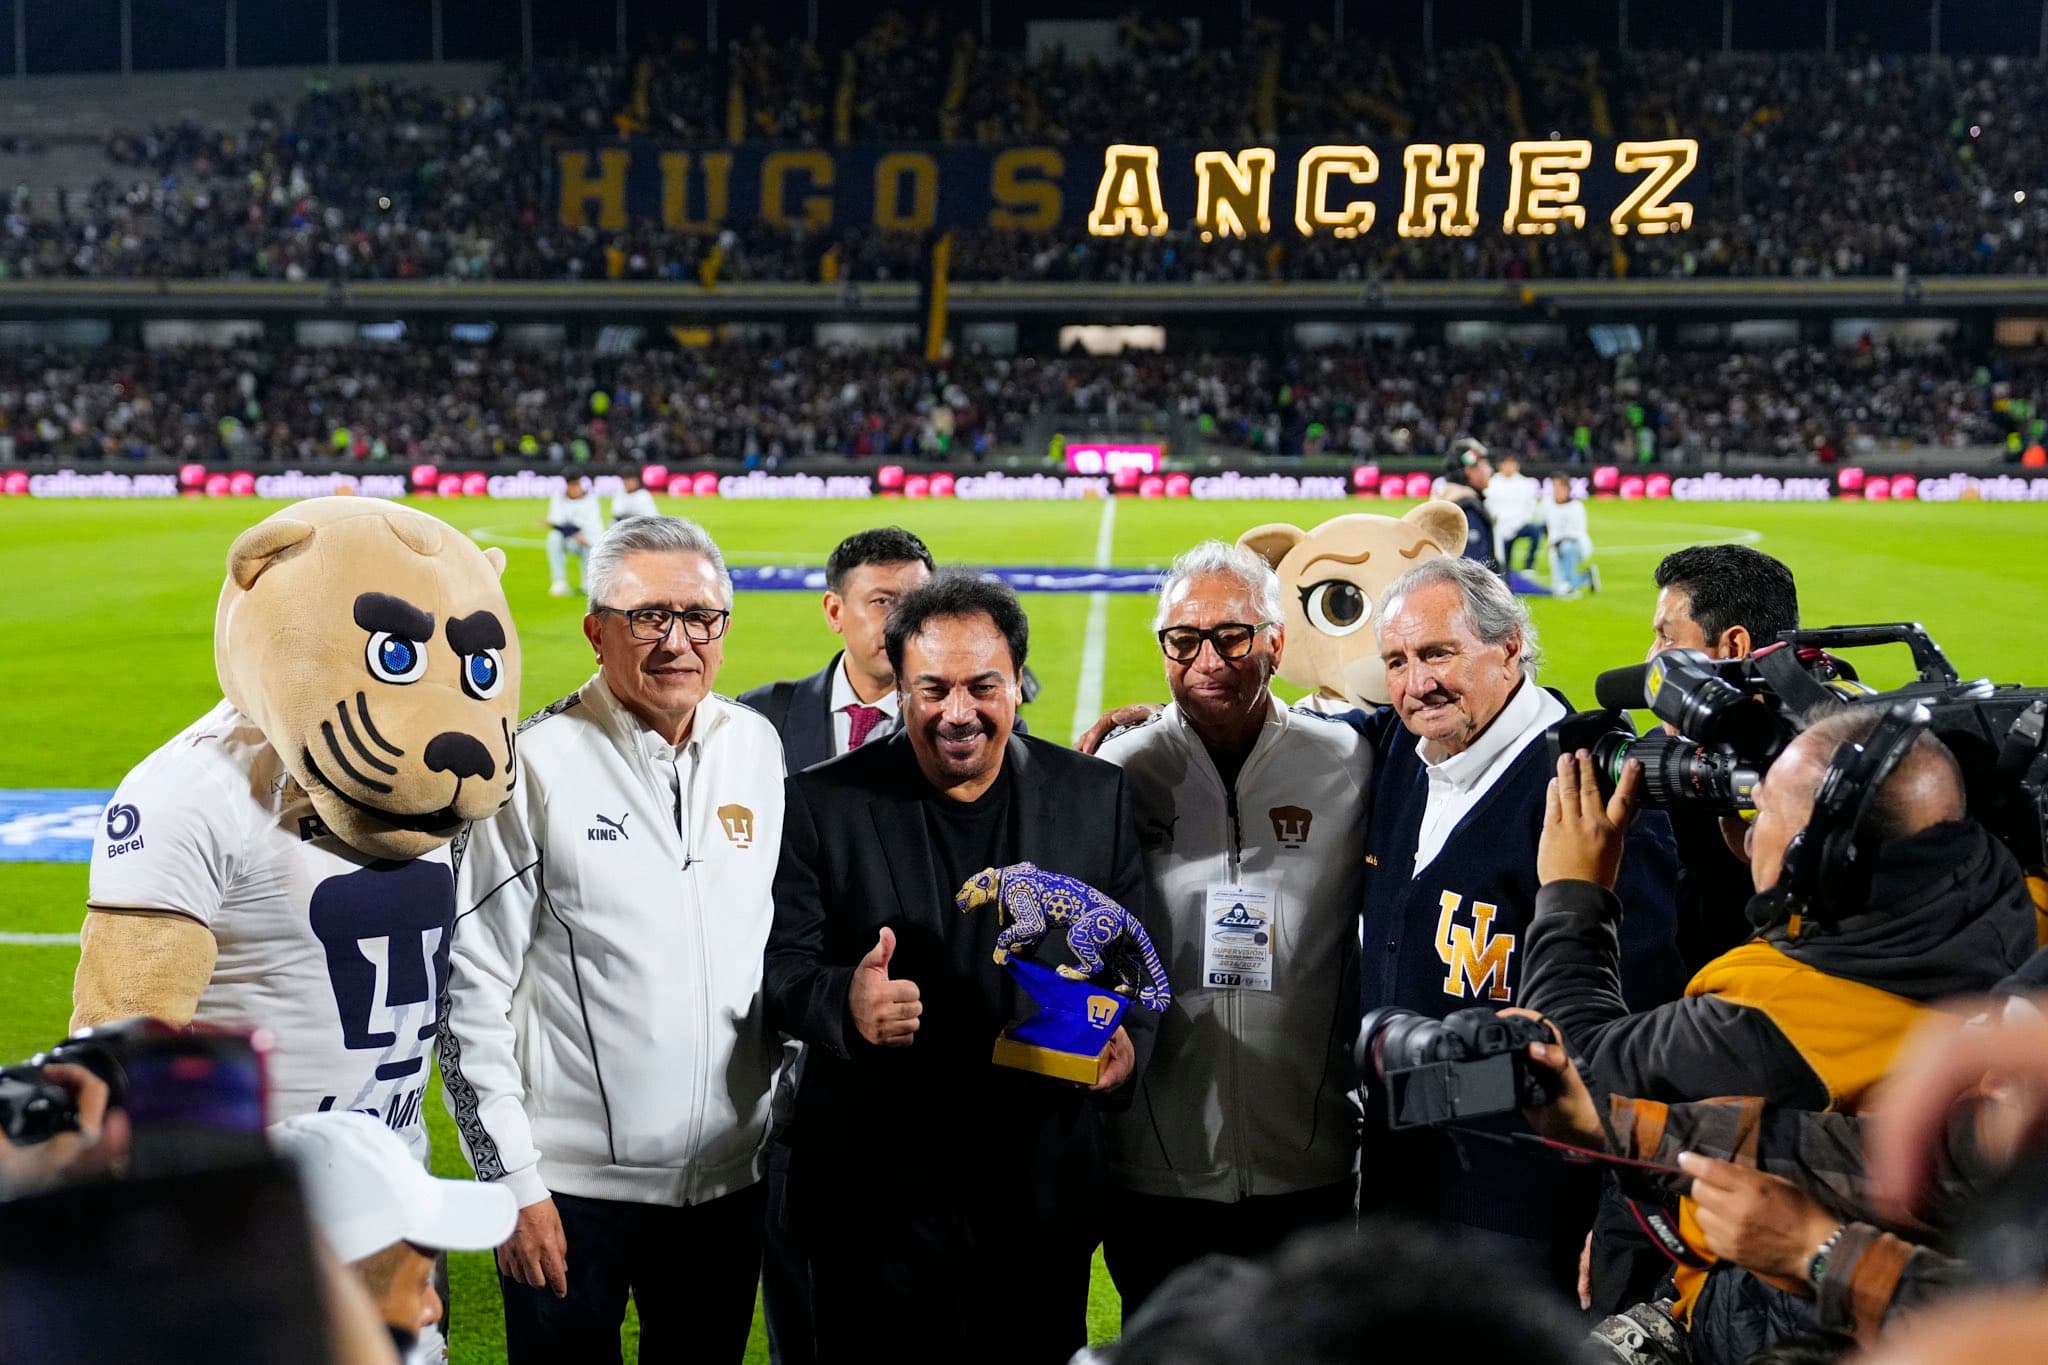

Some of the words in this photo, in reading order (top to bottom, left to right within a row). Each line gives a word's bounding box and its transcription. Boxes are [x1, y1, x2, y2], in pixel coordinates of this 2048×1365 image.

[559, 149, 938, 232] HUGO
[588, 828, 617, 841] KING
[107, 834, 144, 859] Berel
[1214, 974, 1238, 985] 017
